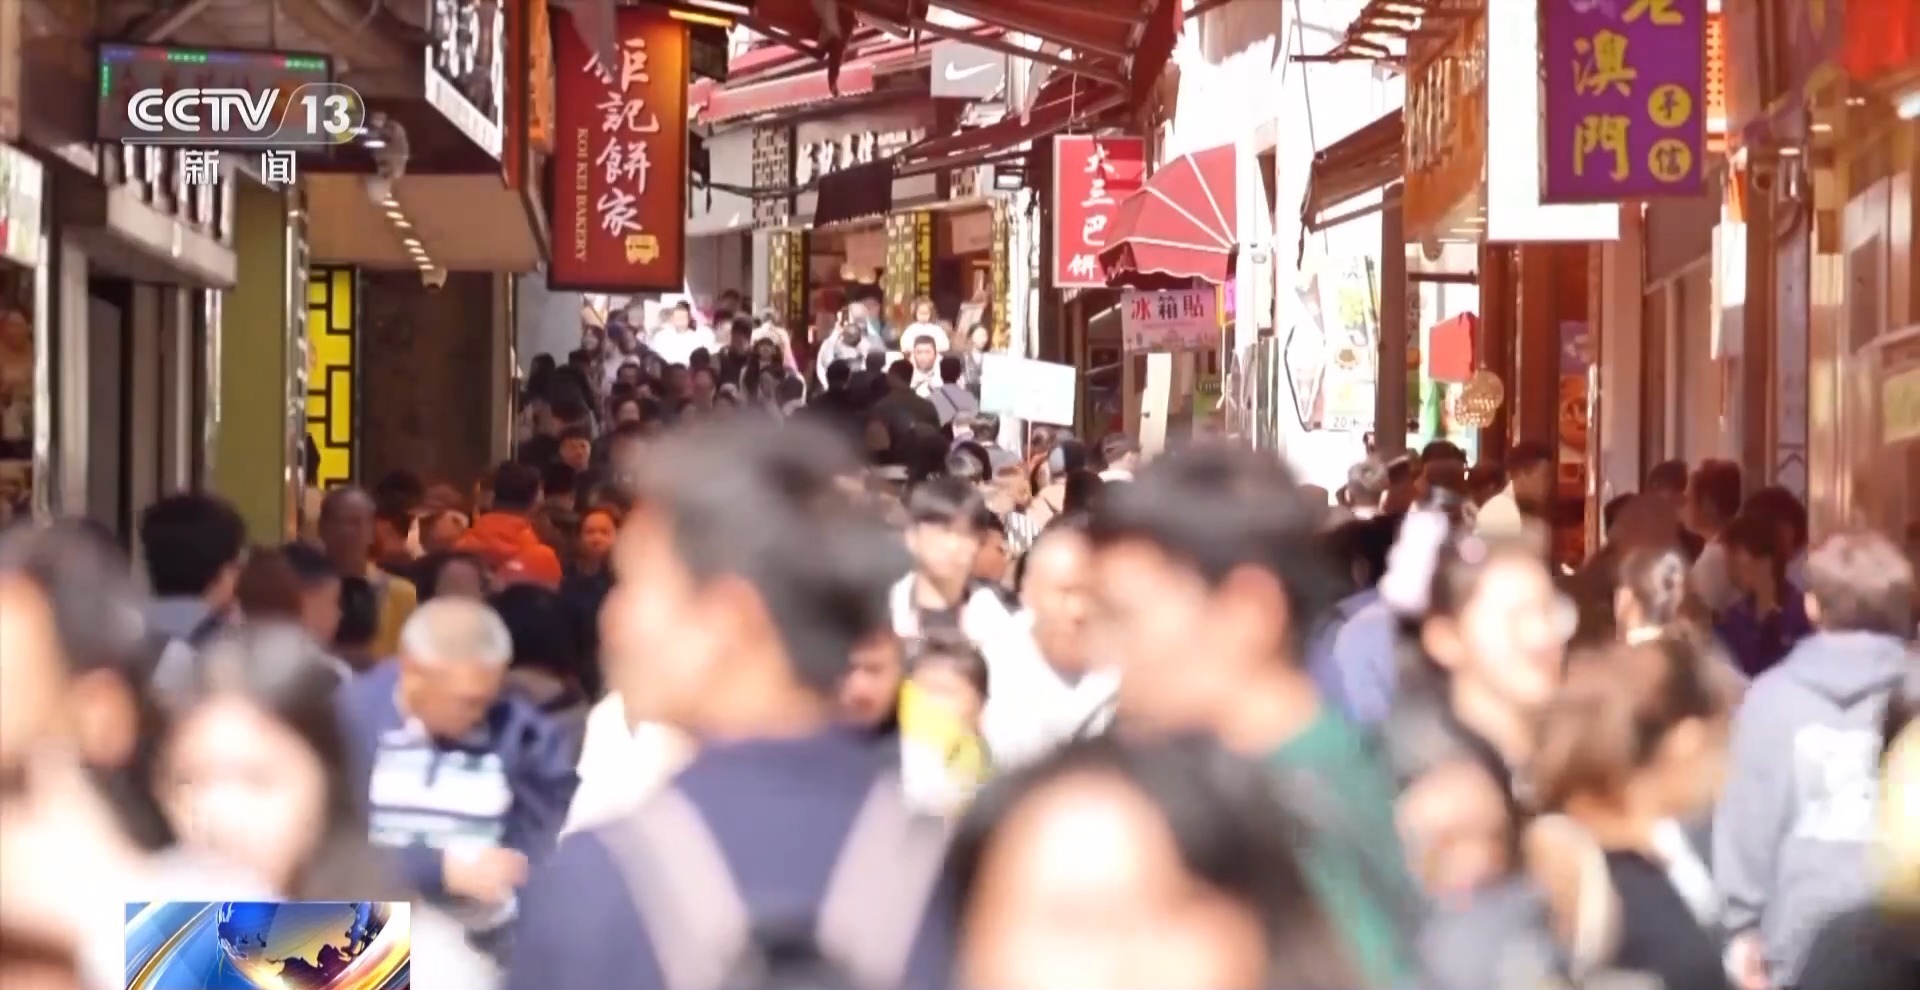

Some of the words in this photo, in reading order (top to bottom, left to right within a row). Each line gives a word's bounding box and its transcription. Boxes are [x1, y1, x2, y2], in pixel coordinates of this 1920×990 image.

[577, 128, 589, 158] KOI
[576, 163, 588, 191] KEI
[575, 194, 587, 262] BAKERY
[1131, 293, 1205, 321] 冰箱貼
